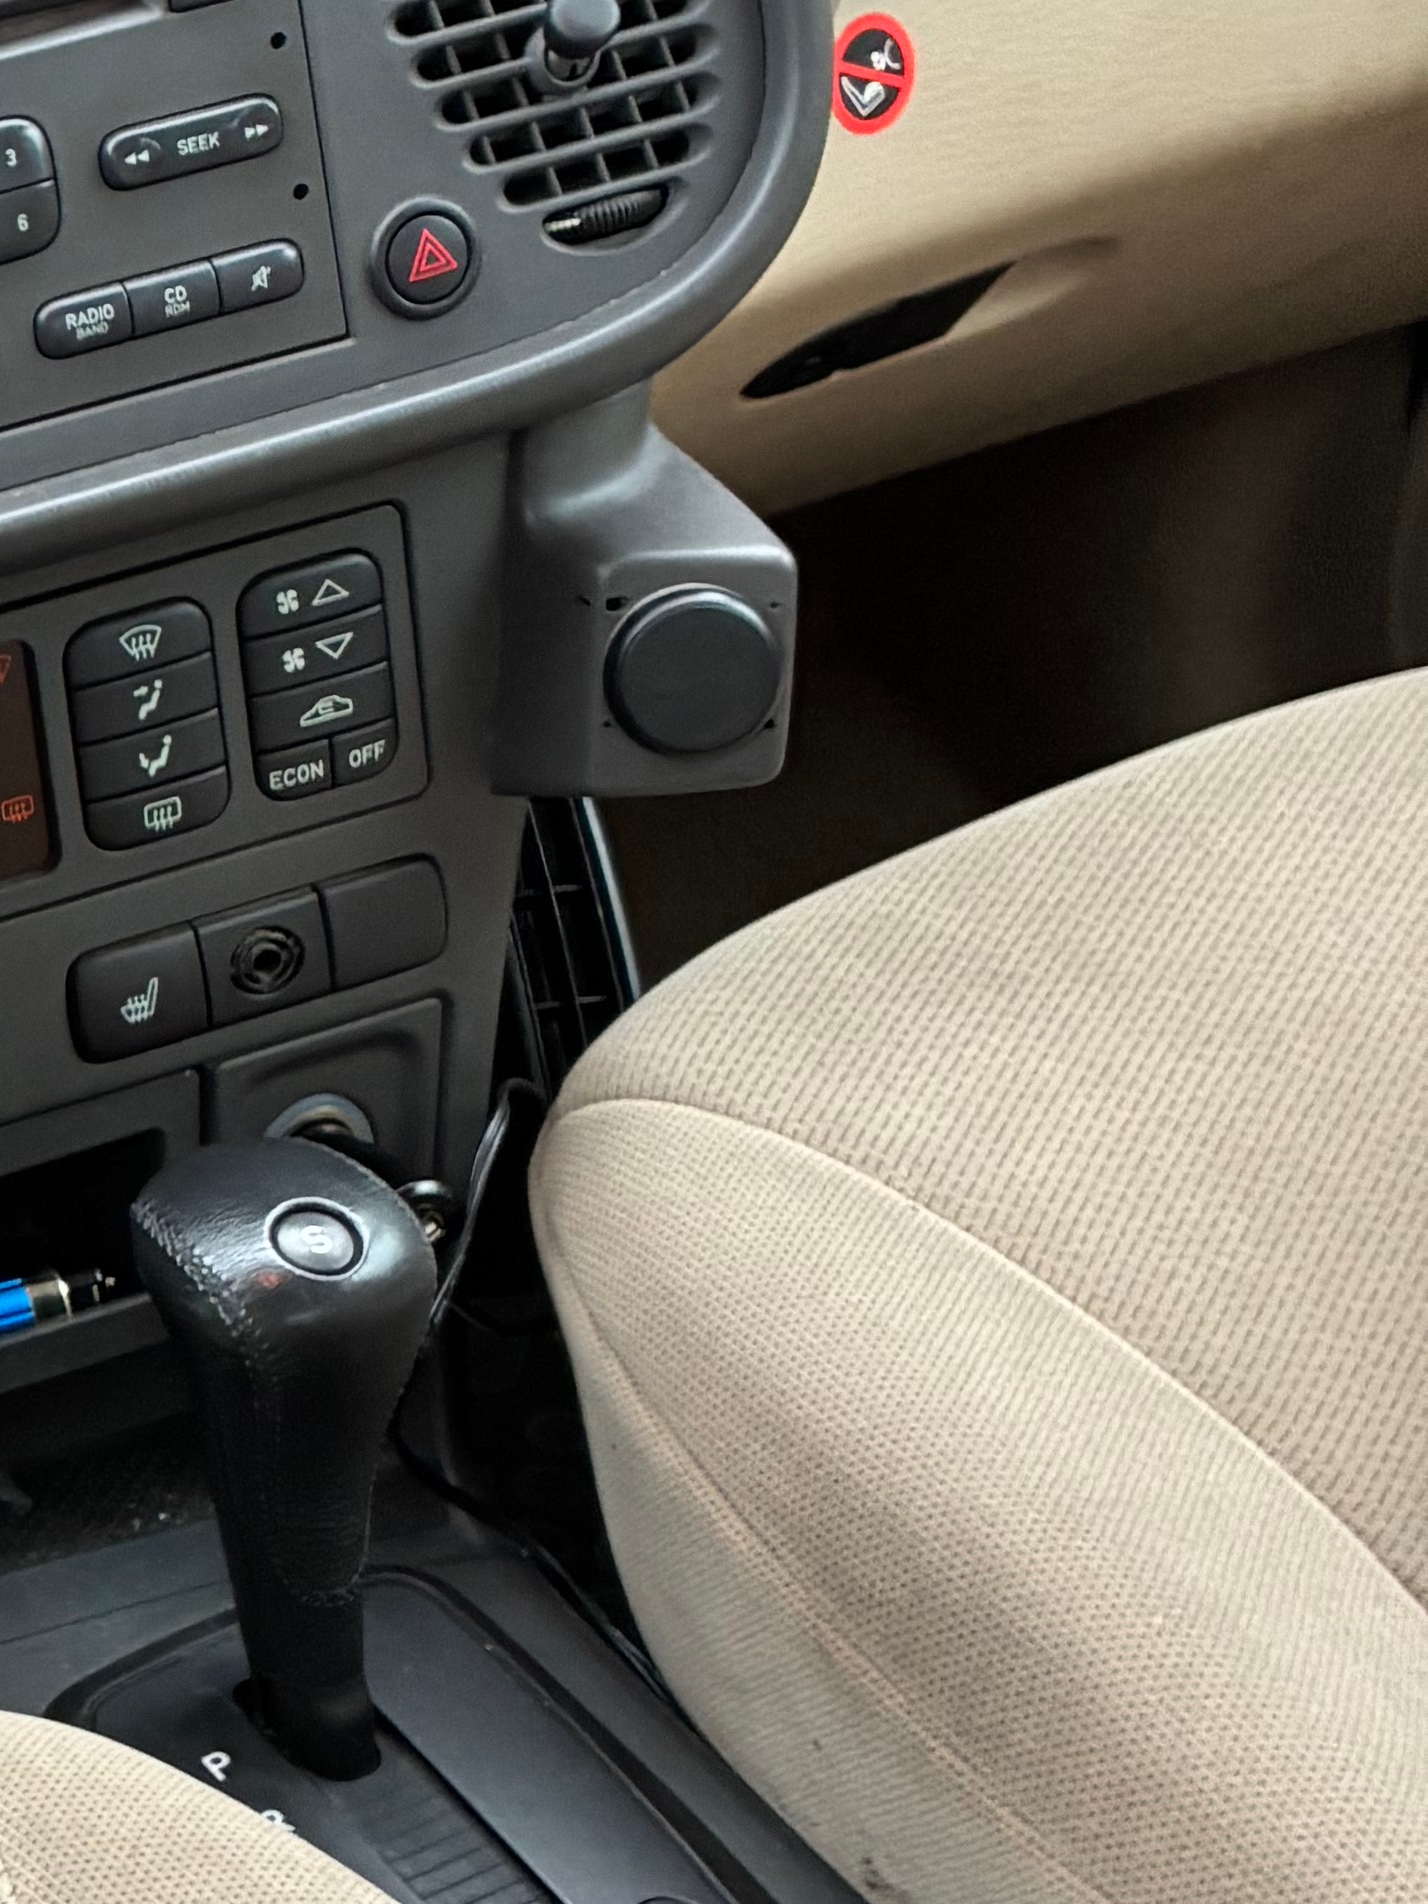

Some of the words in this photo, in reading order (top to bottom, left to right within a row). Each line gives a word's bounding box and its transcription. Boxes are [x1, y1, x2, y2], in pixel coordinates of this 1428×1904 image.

[5, 148, 17, 168] 3
[176, 132, 220, 156] SEEK
[17, 213, 29, 233] 6
[164, 285, 188, 304] CD
[65, 303, 115, 331] RADIO
[348, 739, 386, 769] OFF
[268, 759, 325, 792] ECON
[300, 1225, 333, 1254] S
[201, 1751, 231, 1781] P
